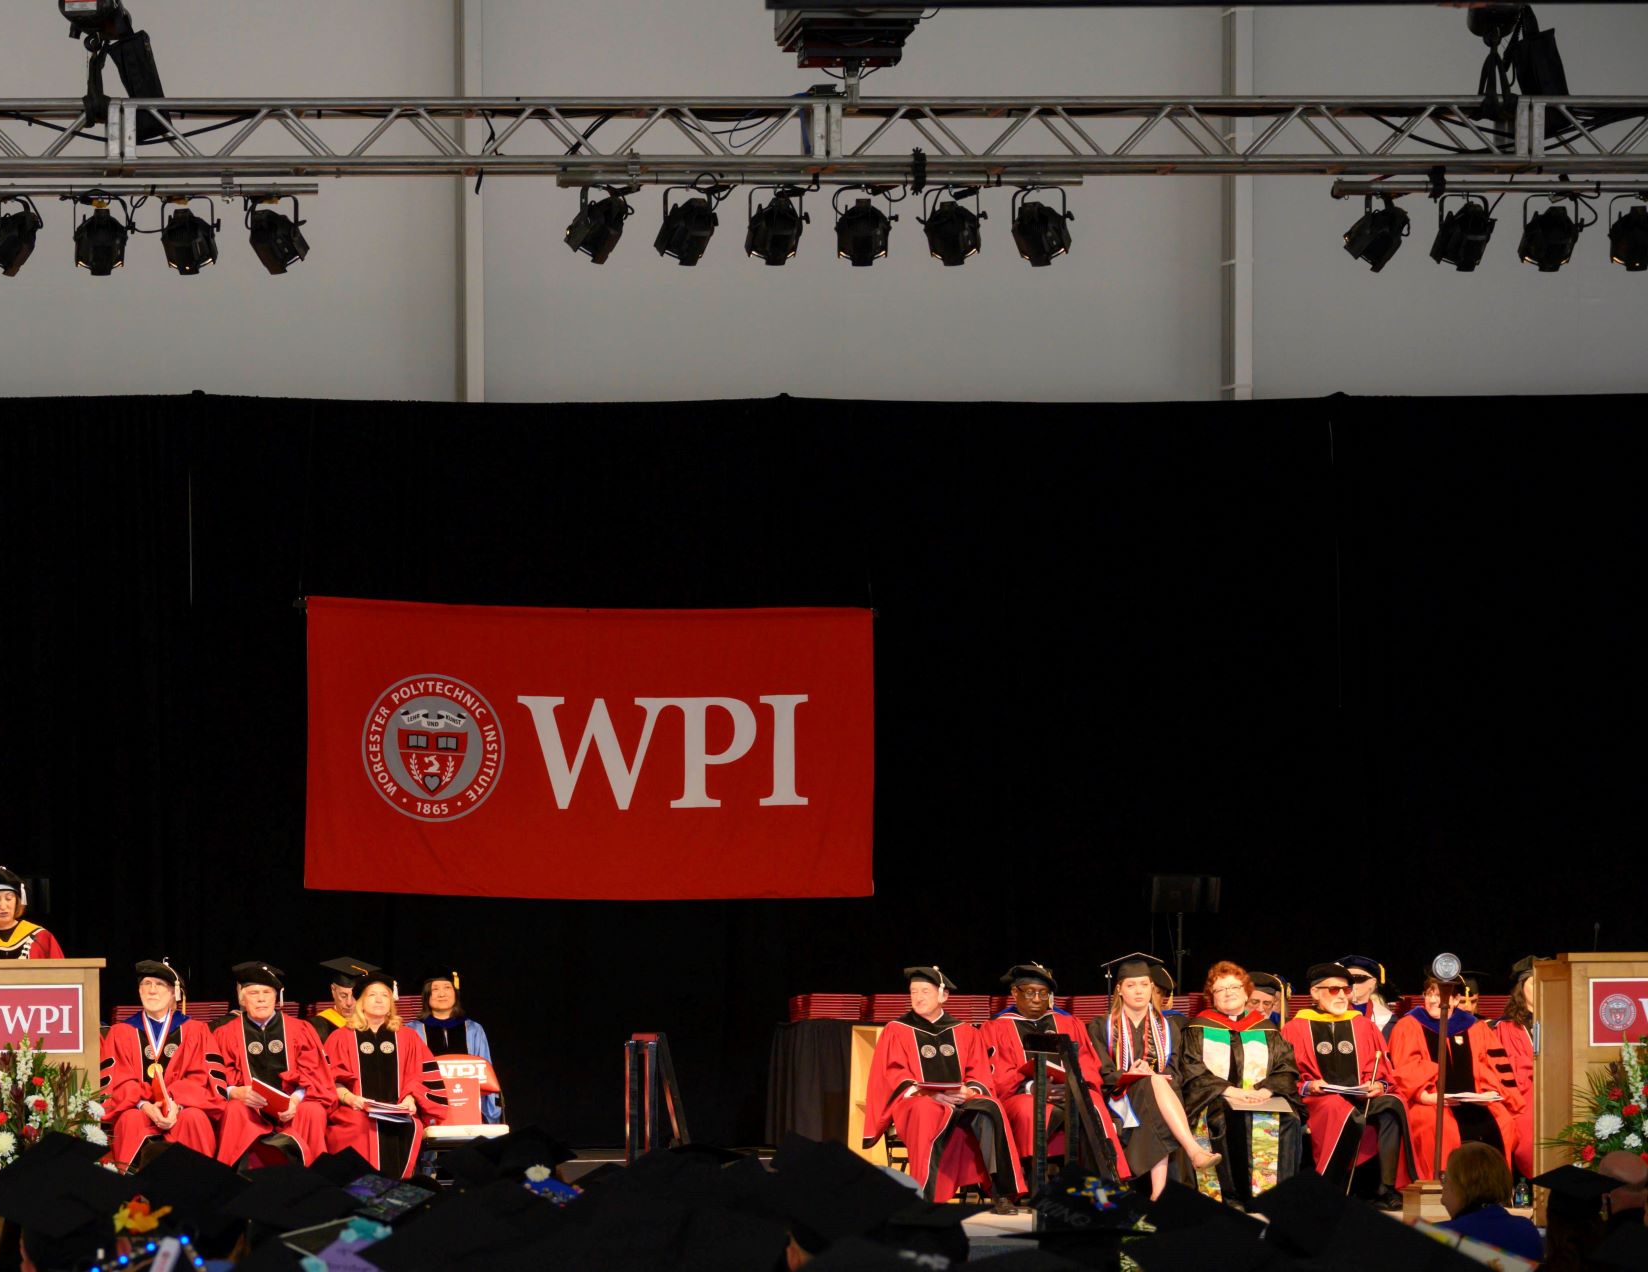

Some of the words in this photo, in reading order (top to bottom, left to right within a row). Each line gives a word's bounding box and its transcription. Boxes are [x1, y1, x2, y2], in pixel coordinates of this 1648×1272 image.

[369, 706, 397, 797] WORCESTER
[391, 681, 487, 719] POLYTECHNIC
[465, 724, 498, 802] INSTITUTE
[517, 694, 808, 810] WPI
[416, 802, 449, 815] 1865
